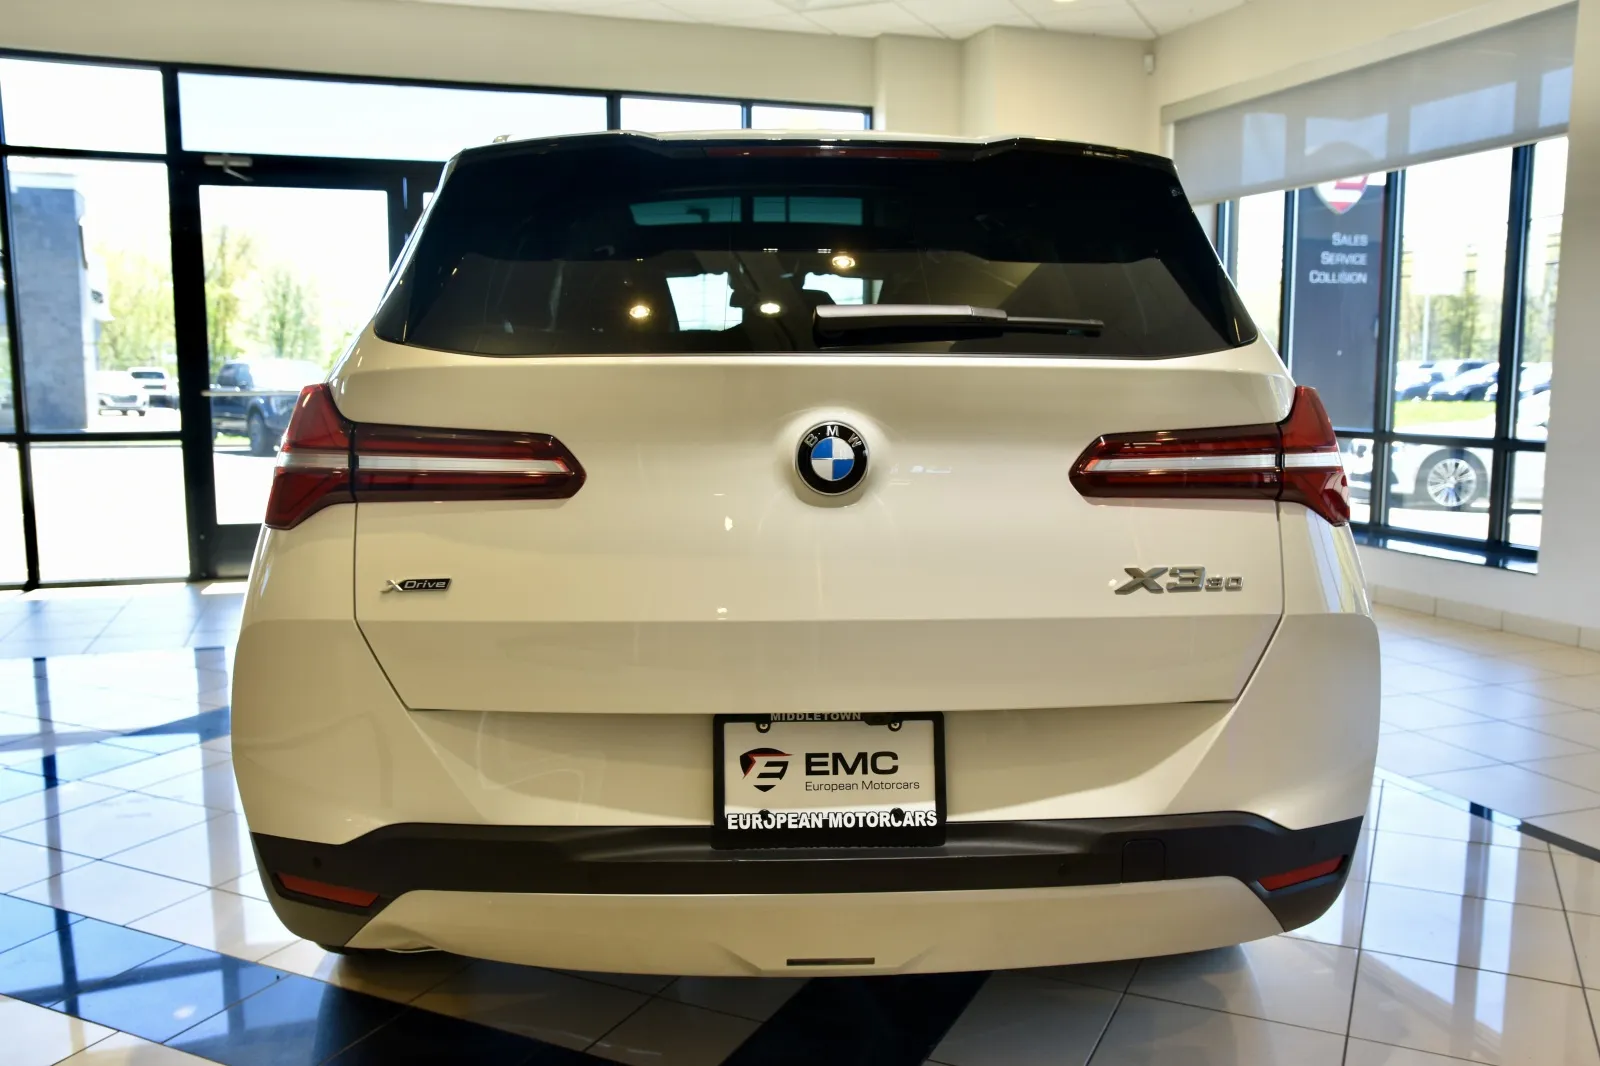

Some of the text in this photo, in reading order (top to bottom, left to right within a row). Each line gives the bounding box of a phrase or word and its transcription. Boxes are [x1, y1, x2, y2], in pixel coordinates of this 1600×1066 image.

[804, 425, 862, 448] BMW
[770, 712, 861, 721] MIDDLETOWN
[805, 751, 899, 776] EMC
[805, 780, 920, 792] European Motorcars
